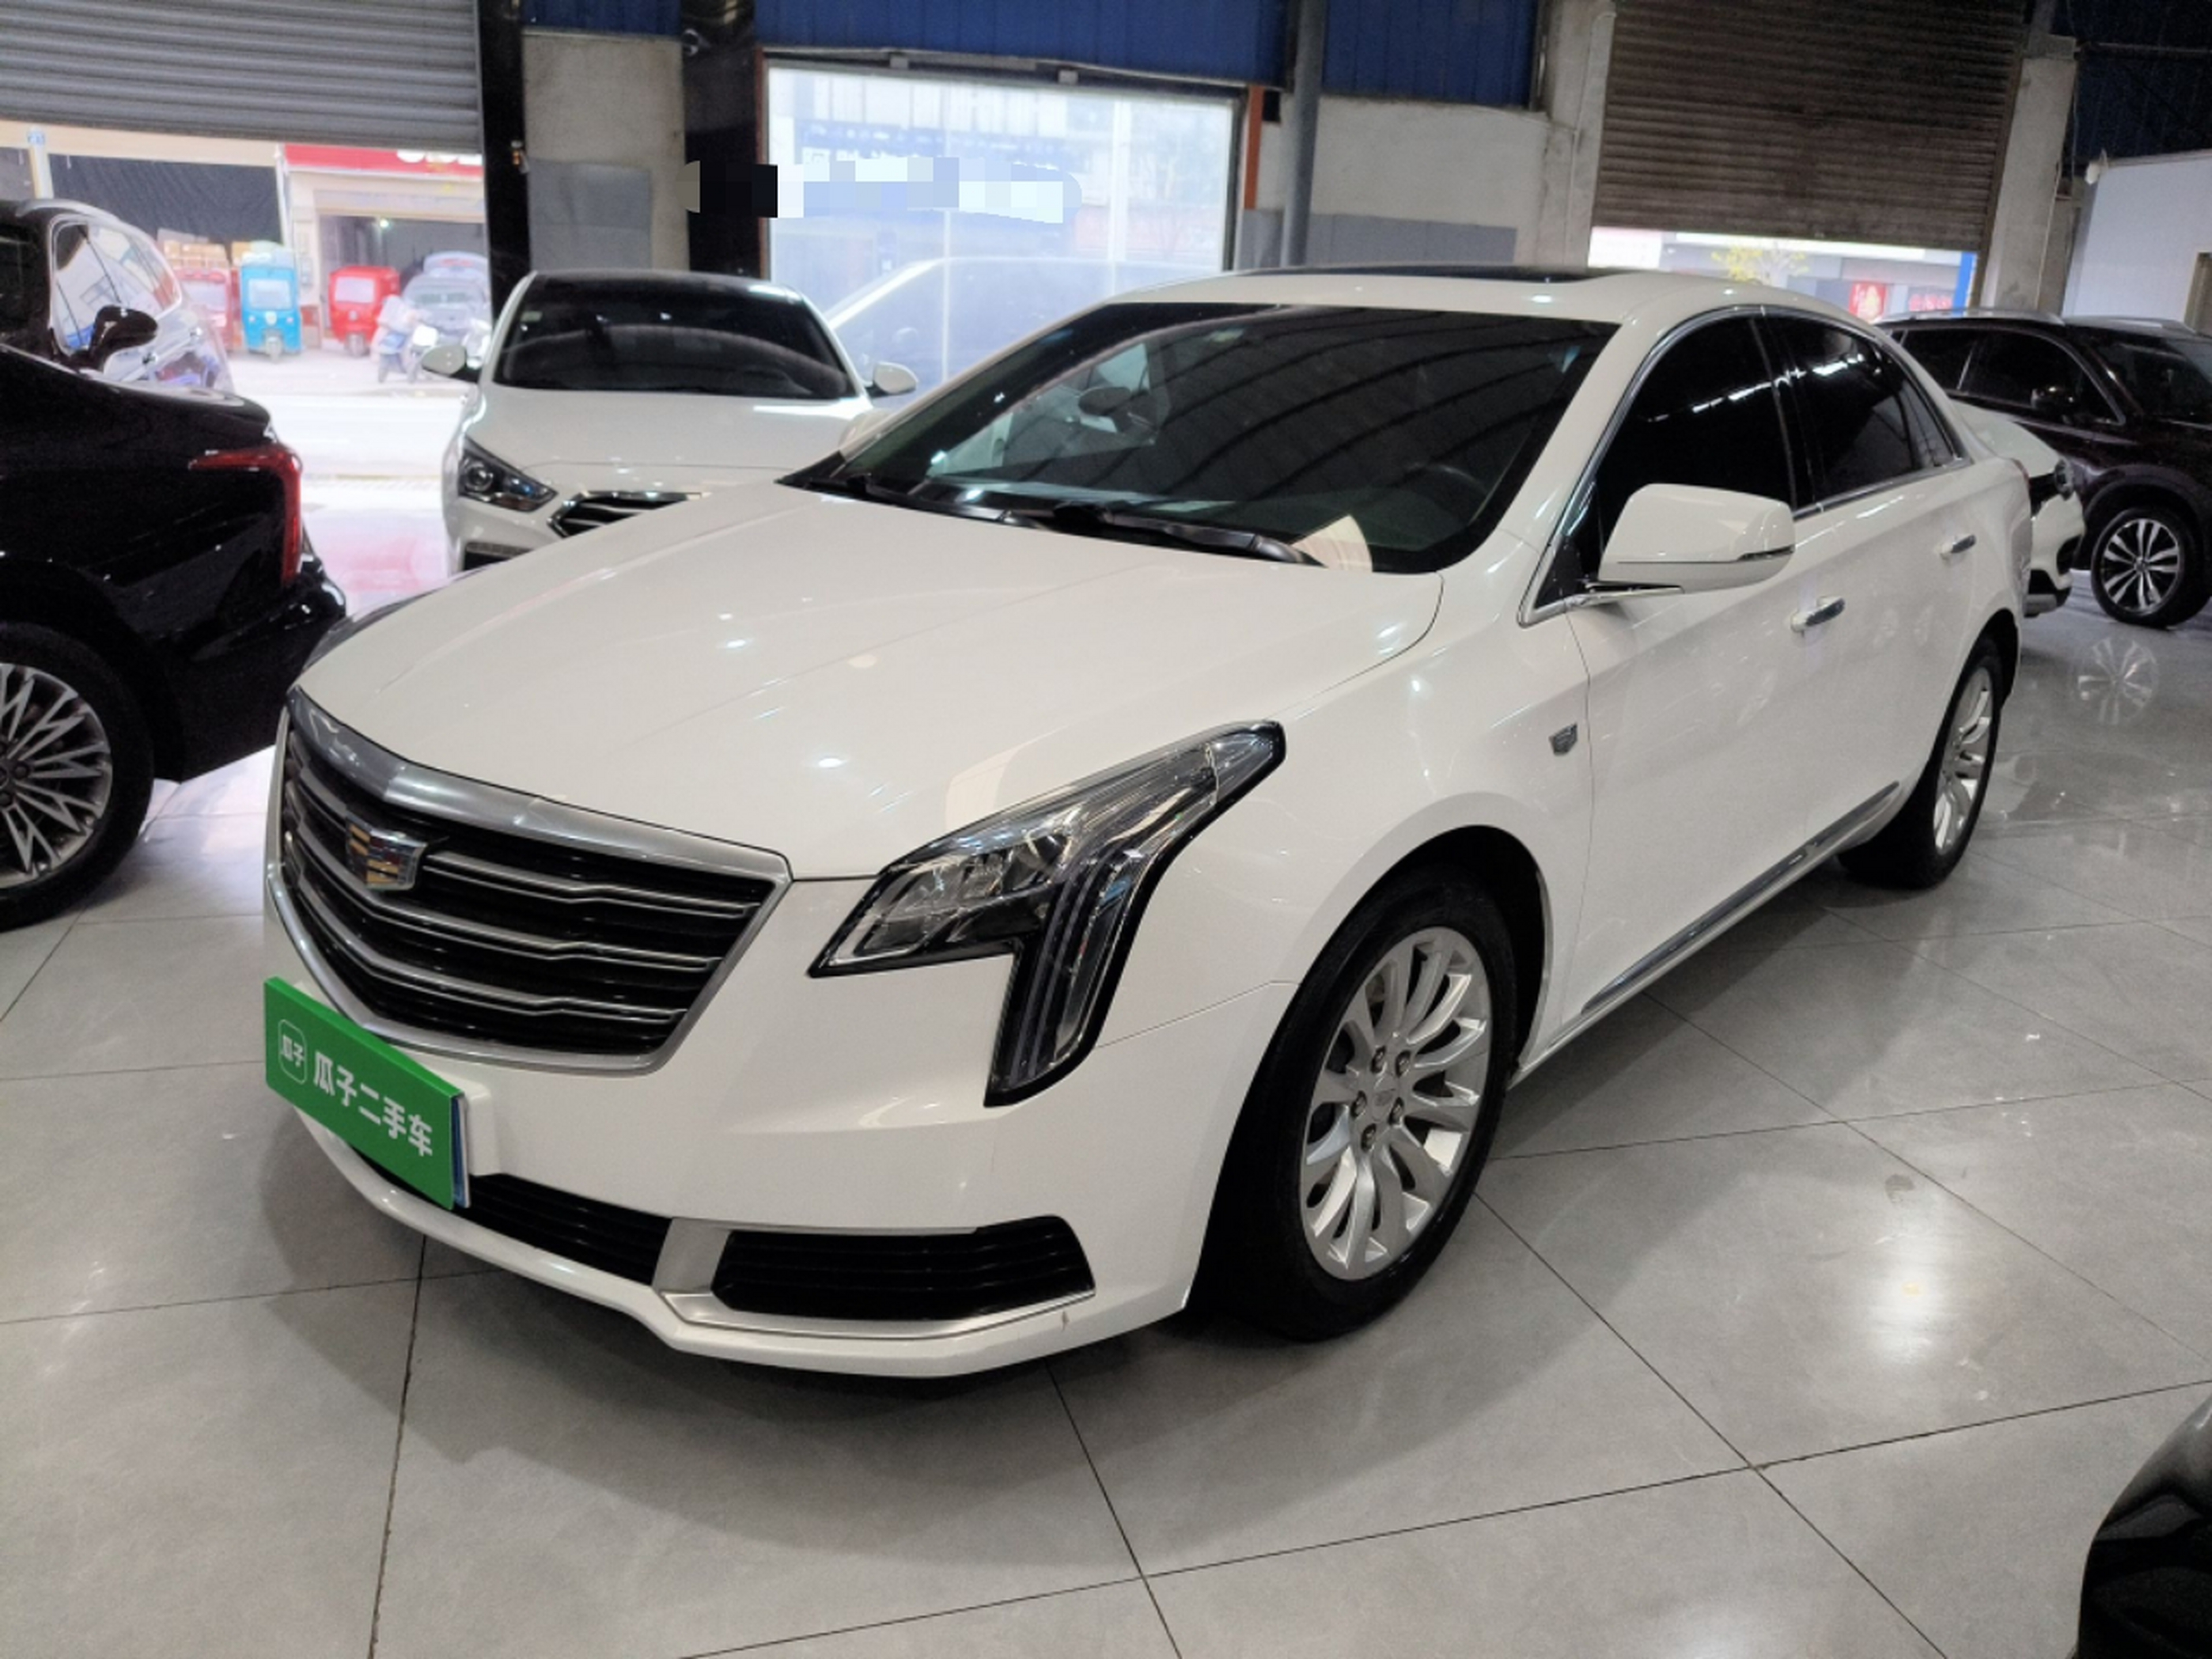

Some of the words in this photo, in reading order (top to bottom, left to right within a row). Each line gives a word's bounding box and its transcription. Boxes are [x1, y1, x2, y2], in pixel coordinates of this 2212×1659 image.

[281, 1035, 305, 1067] 瓜子
[313, 1051, 433, 1157] 瓜子二手车
